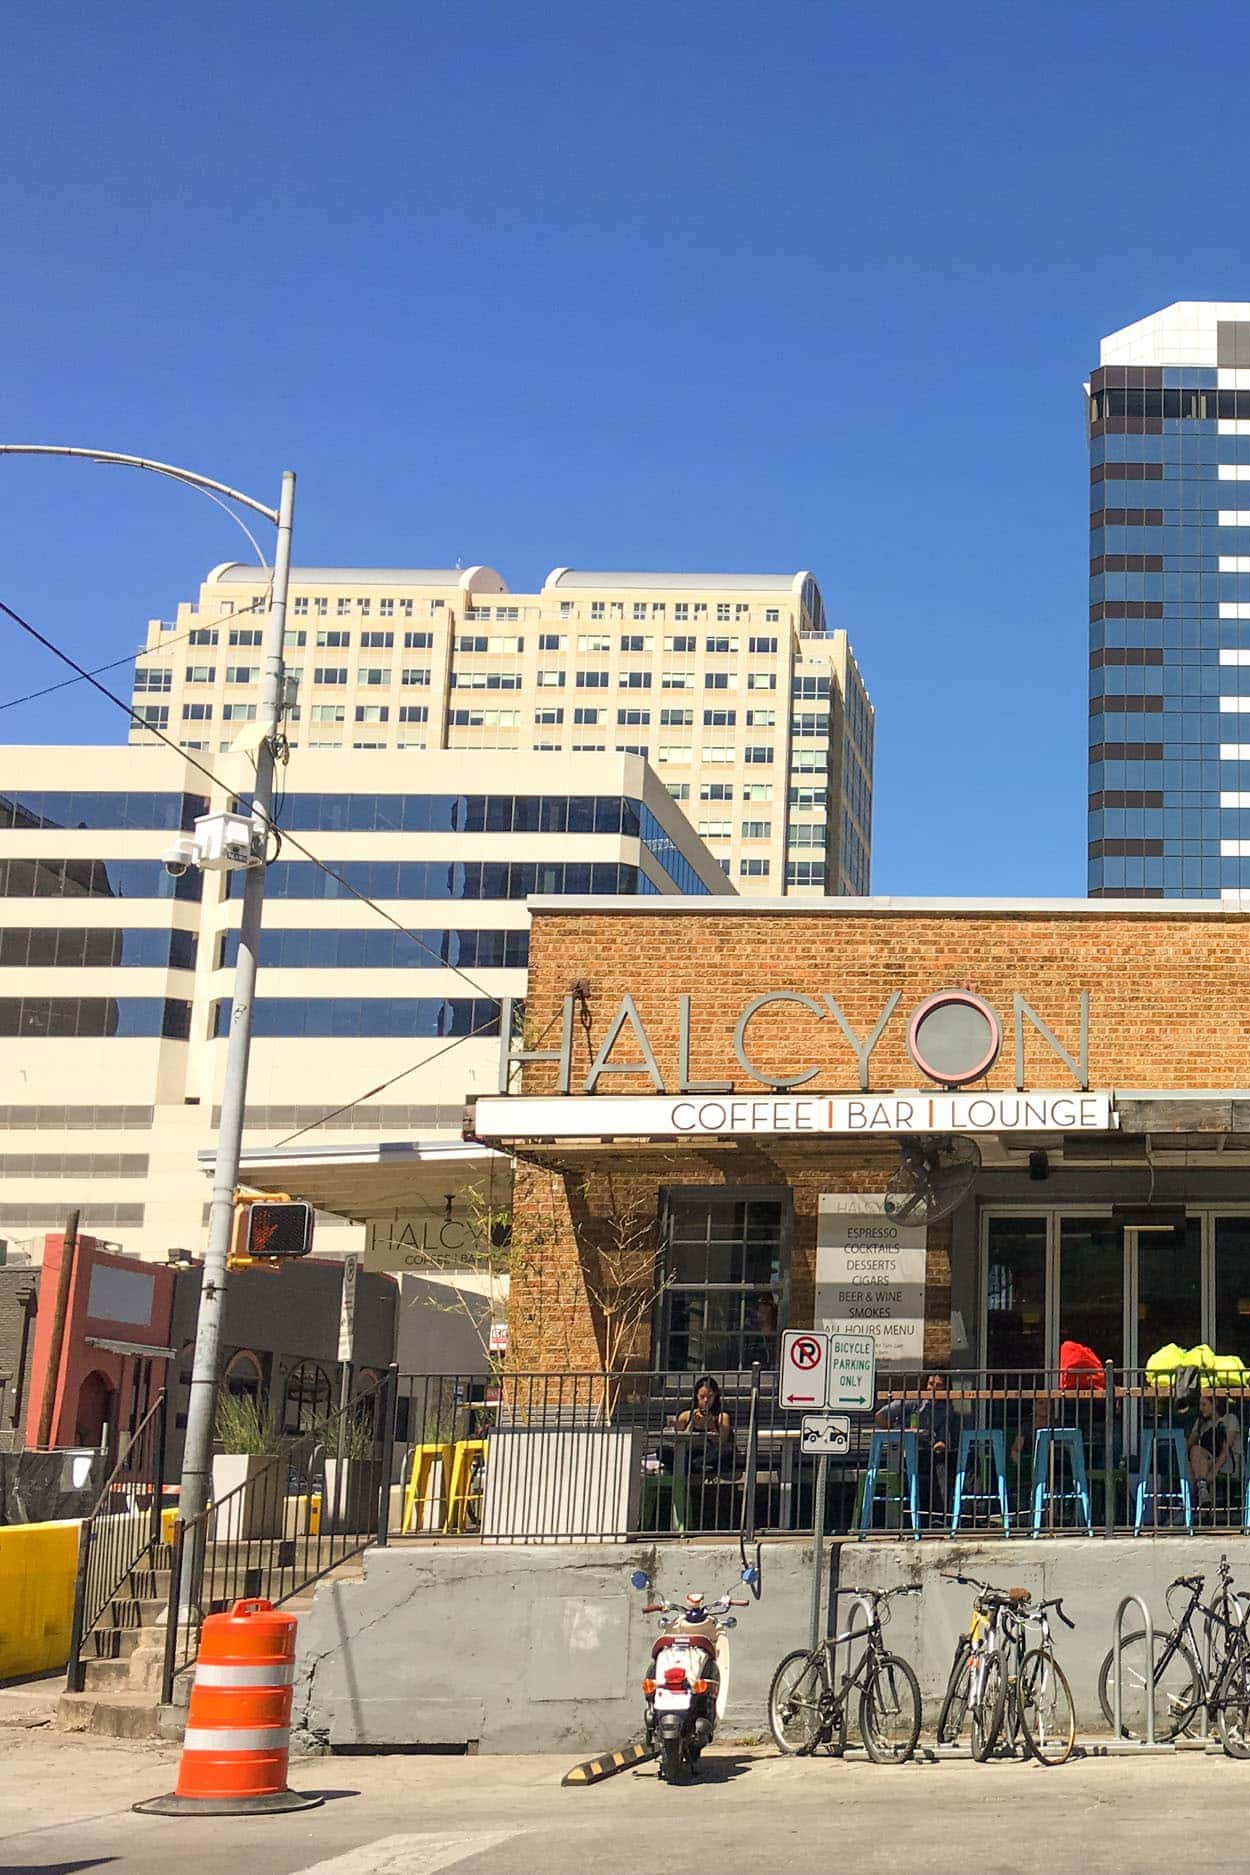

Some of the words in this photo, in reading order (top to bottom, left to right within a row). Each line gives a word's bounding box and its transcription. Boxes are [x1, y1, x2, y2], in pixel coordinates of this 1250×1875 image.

[499, 988, 1089, 1094] HALCYON
[671, 1102, 814, 1131] COFFEE
[847, 1101, 914, 1130] BAR
[951, 1099, 1097, 1128] LOUNGE
[847, 1227, 898, 1239] ESPRESSO
[844, 1243, 900, 1254] COCKTAILS
[405, 1254, 451, 1265] COEE
[846, 1260, 896, 1271] DESSERTS
[851, 1276, 890, 1286] CIGARS
[838, 1291, 863, 1302] BEER
[865, 1292, 873, 1302] &
[876, 1291, 902, 1302] WINE
[849, 1307, 891, 1319] SMOKES
[845, 1325, 880, 1335] HOURS
[883, 1325, 915, 1336] MENU
[834, 1342, 870, 1354] BICYCLE
[833, 1359, 870, 1371] PARKING
[840, 1376, 863, 1387] ONLY
